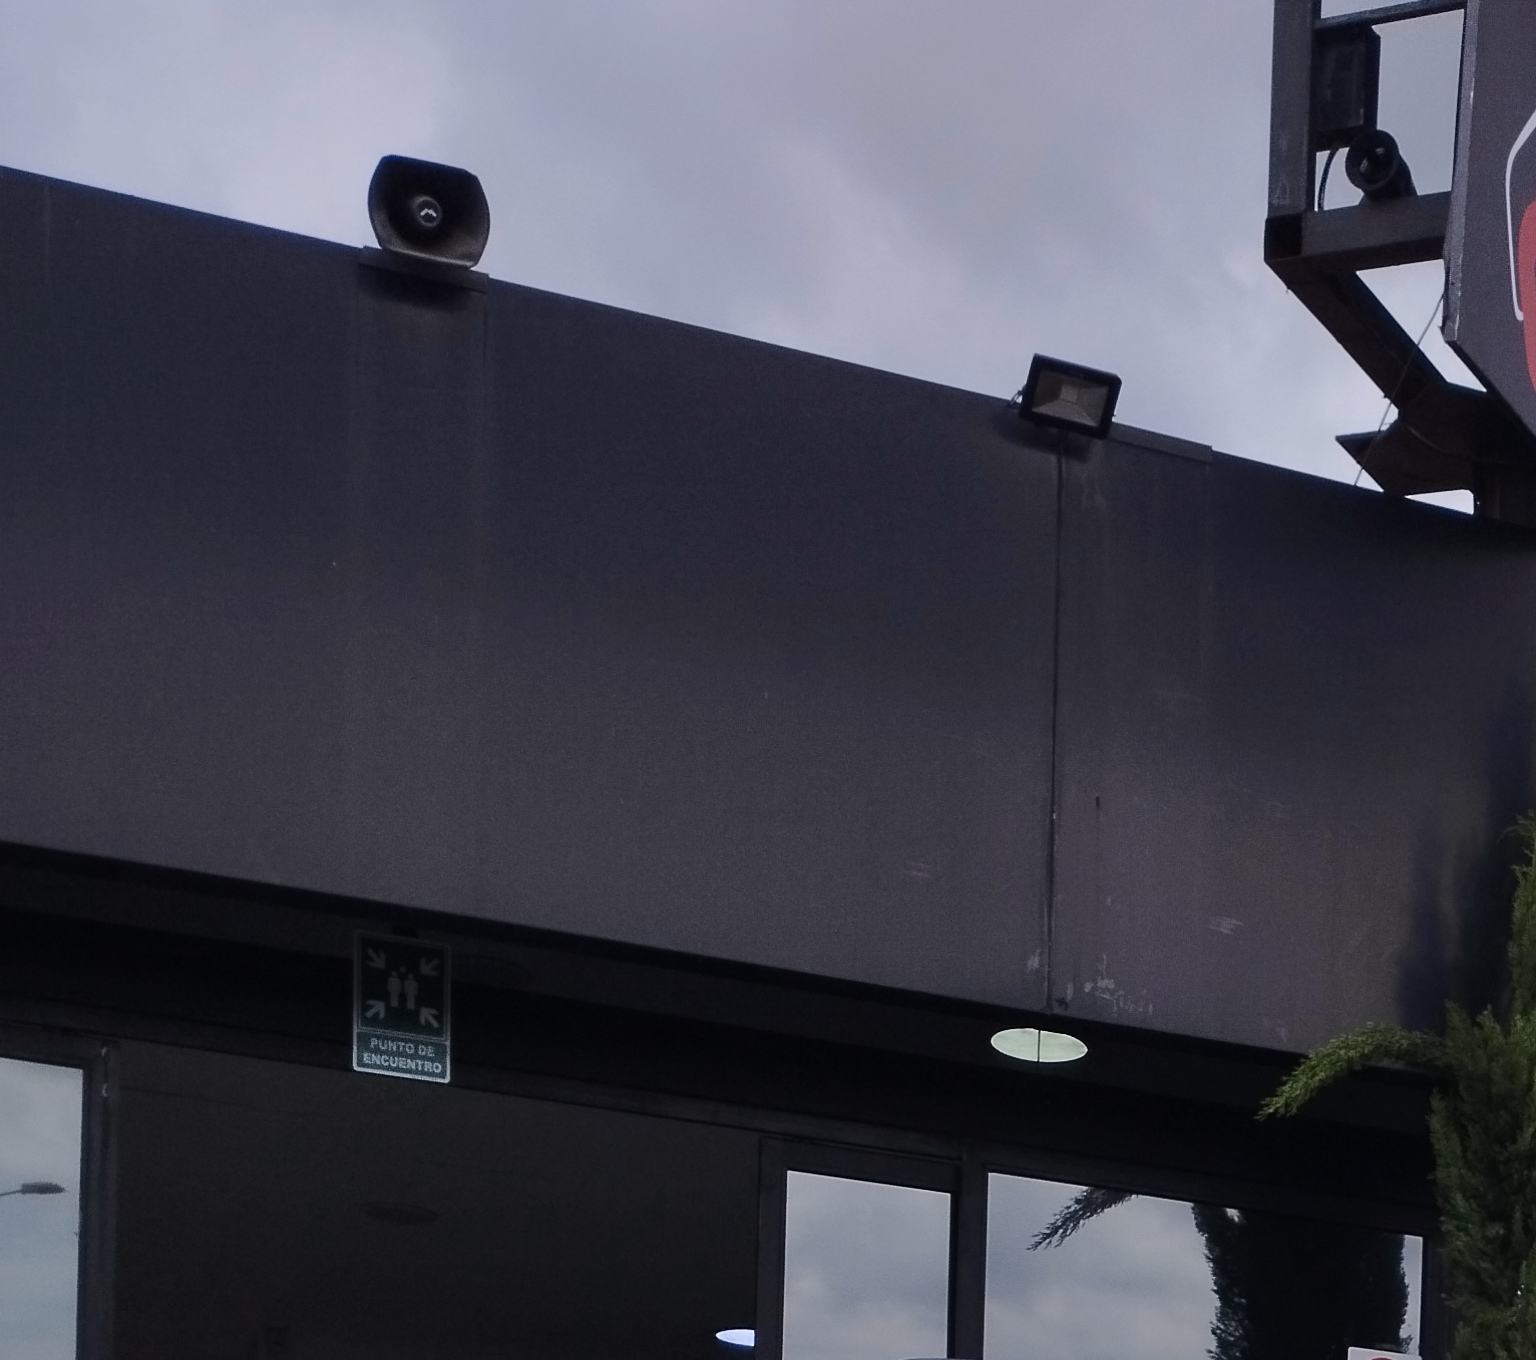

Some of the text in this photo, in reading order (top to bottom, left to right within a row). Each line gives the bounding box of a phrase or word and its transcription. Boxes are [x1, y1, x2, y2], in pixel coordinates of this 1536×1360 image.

[370, 1038, 435, 1057] PUNTO DE
[363, 1052, 442, 1073] ENCUENTRO
